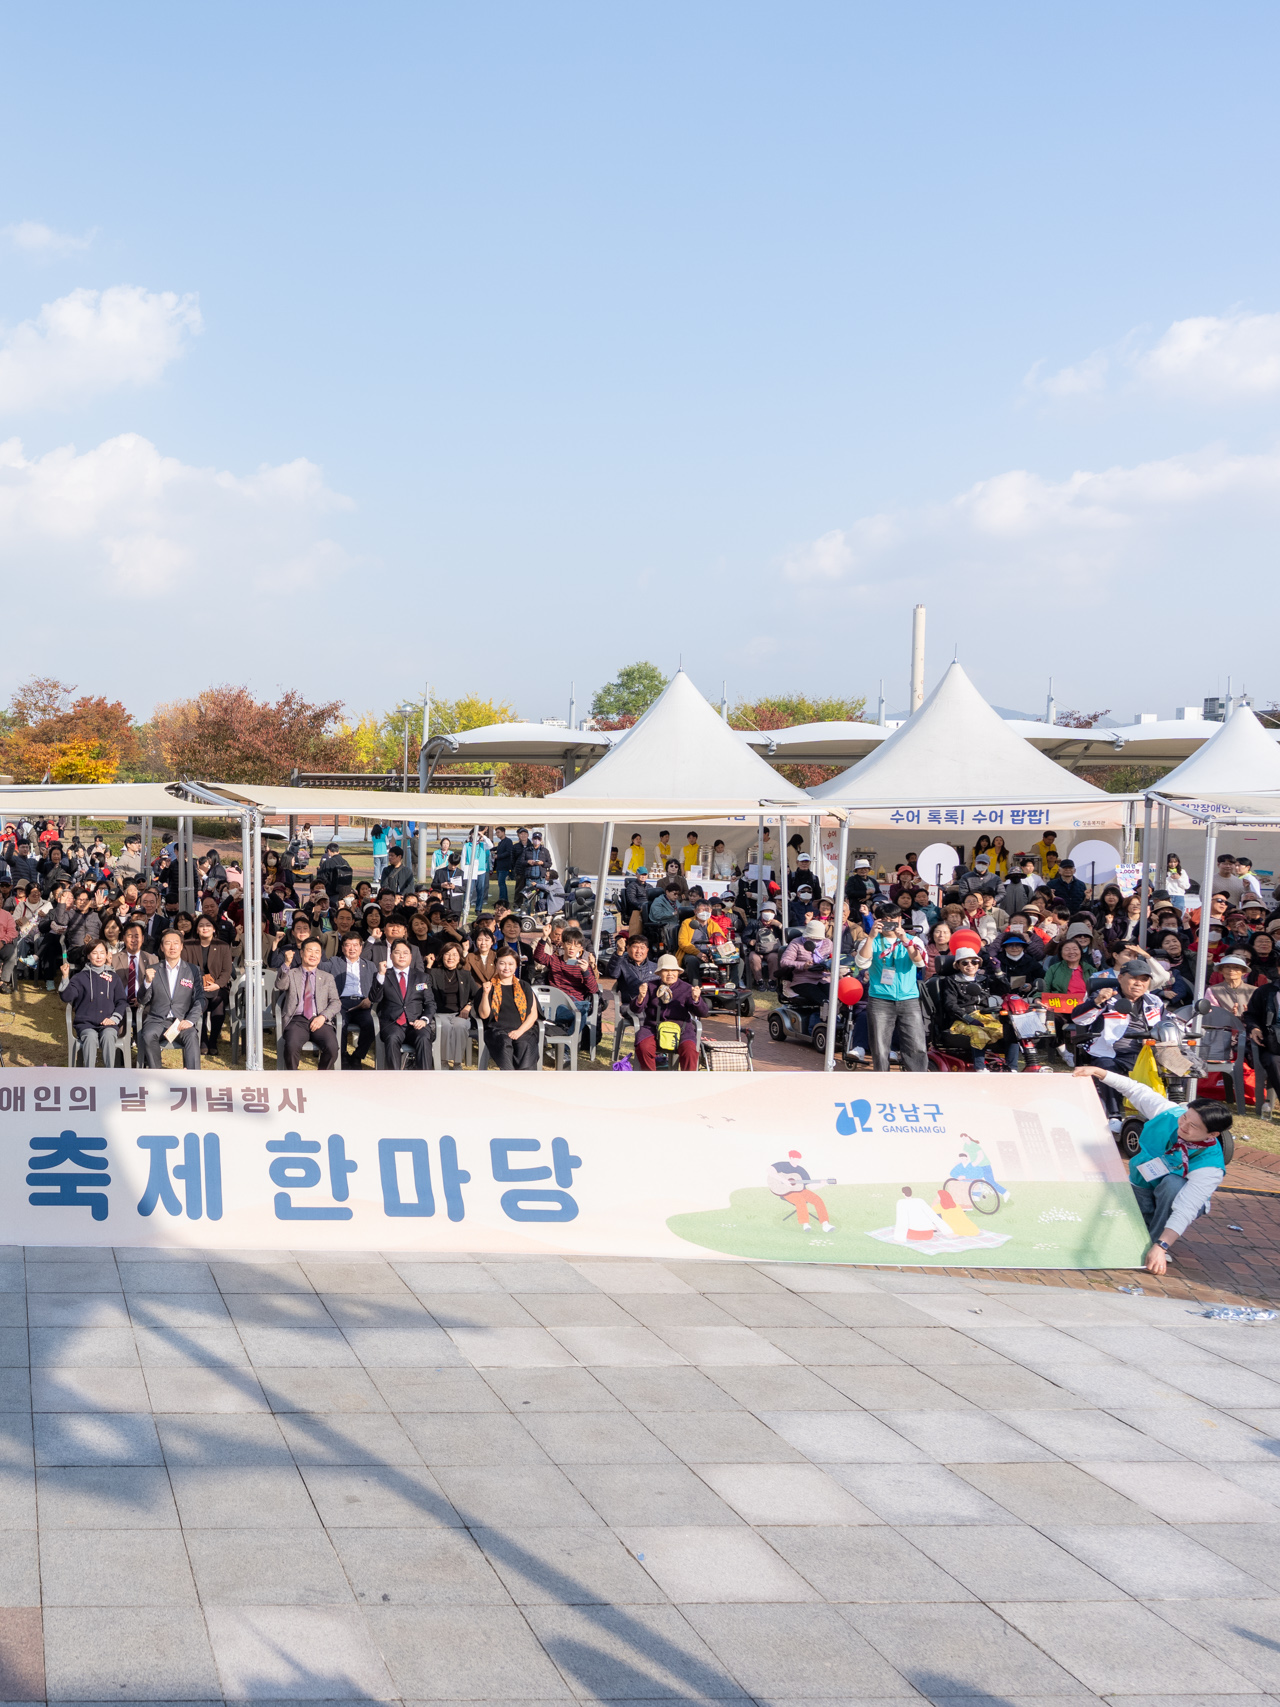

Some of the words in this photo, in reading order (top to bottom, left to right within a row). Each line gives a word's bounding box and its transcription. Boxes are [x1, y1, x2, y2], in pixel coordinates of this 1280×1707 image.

[890, 809, 920, 825] 수어
[927, 809, 965, 825] 톡톡!
[972, 809, 1004, 825] 수어
[1010, 809, 1049, 825] 팝팝!
[119, 1086, 149, 1113] 날
[169, 1086, 308, 1114] 기념행사
[876, 1103, 944, 1123] 강남구
[882, 1125, 910, 1133] GANG
[910, 1126, 931, 1134] NAM
[932, 1126, 946, 1134] GU
[25, 1129, 224, 1222] 축제
[265, 1131, 583, 1223] 한마당
